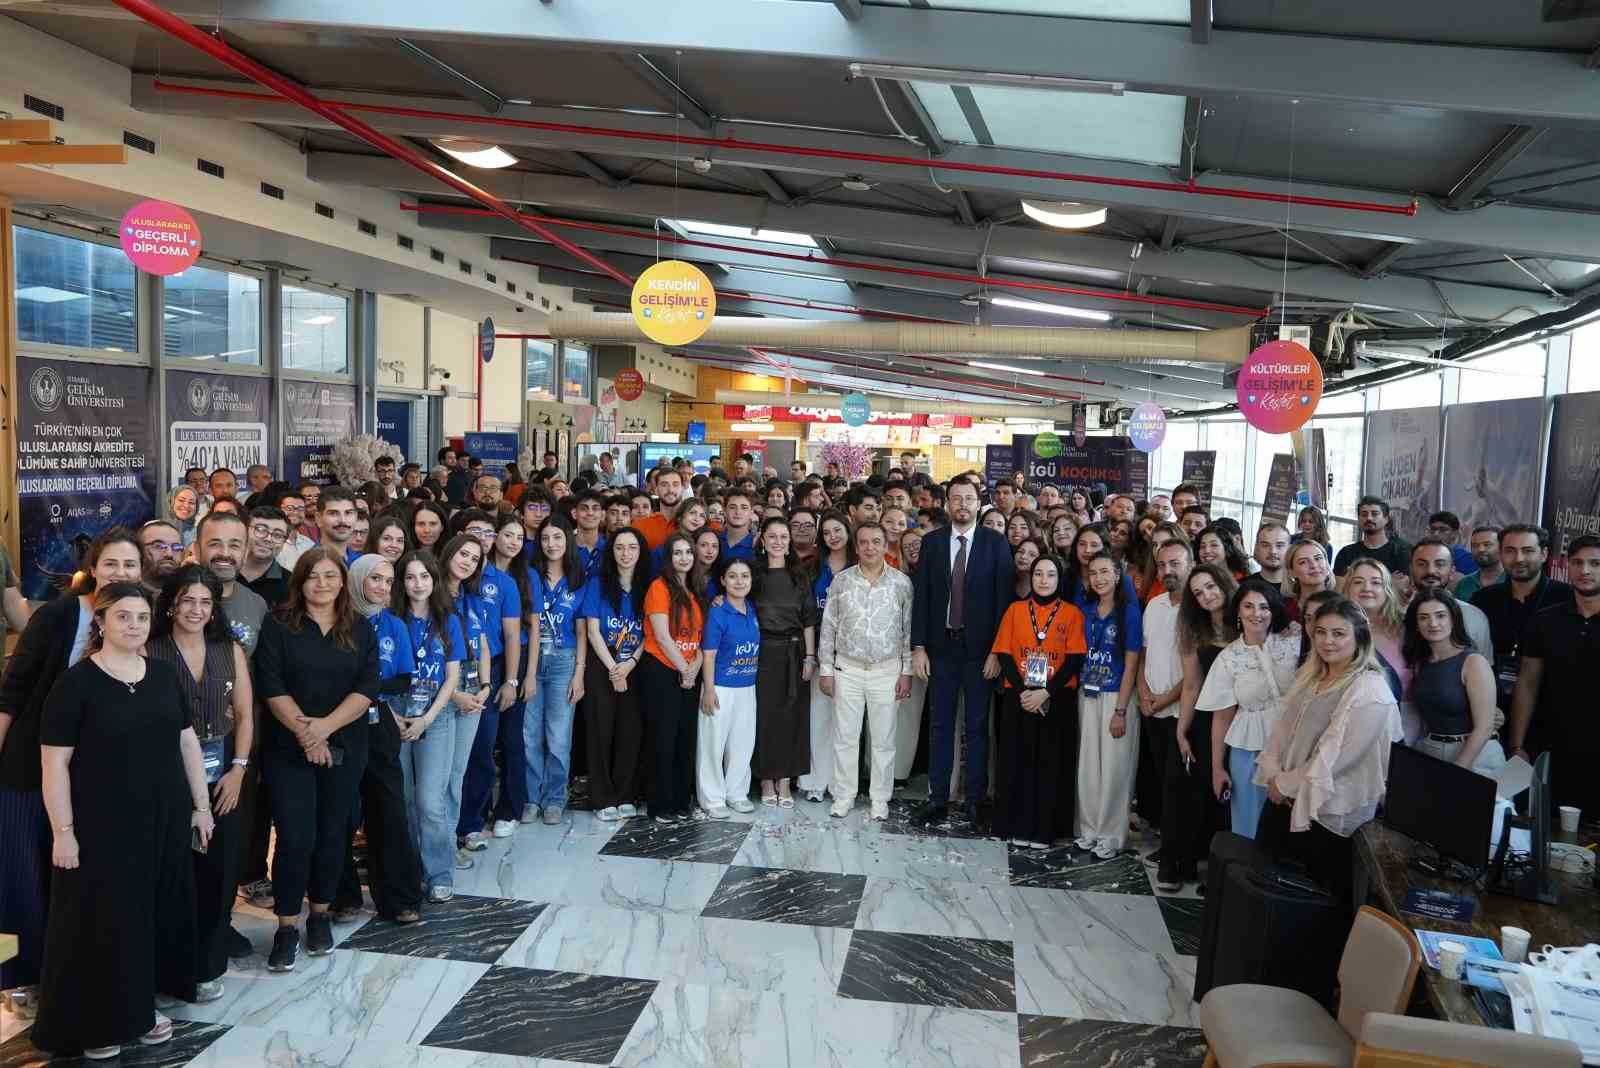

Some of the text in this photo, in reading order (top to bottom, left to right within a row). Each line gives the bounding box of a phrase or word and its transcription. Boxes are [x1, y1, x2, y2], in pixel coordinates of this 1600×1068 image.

[131, 217, 191, 231] ULUSLARARASI
[135, 229, 187, 243] GEÇERLİ
[132, 241, 189, 256] DİPLOMA
[648, 277, 700, 292] KENDİNİ
[639, 292, 709, 308] GELİŞİM'LE
[1250, 362, 1311, 375] KÜLTÜRLERİ
[67, 383, 104, 396] GELİŞİM
[1245, 376, 1314, 393] GELİŞİM'LE
[34, 422, 122, 439] TÜRKİYE'NİN EN ÇOK
[20, 440, 134, 453] ULUSLARARASI AKREDİTE
[61, 457, 87, 469] SAHİP
[89, 455, 144, 468] ÜNİVERSİTESİ
[223, 445, 260, 470] VARAN
[1029, 462, 1057, 477] İGÜ
[76, 475, 106, 493] GEÇERLİ
[107, 474, 137, 489] DİPLOMA
